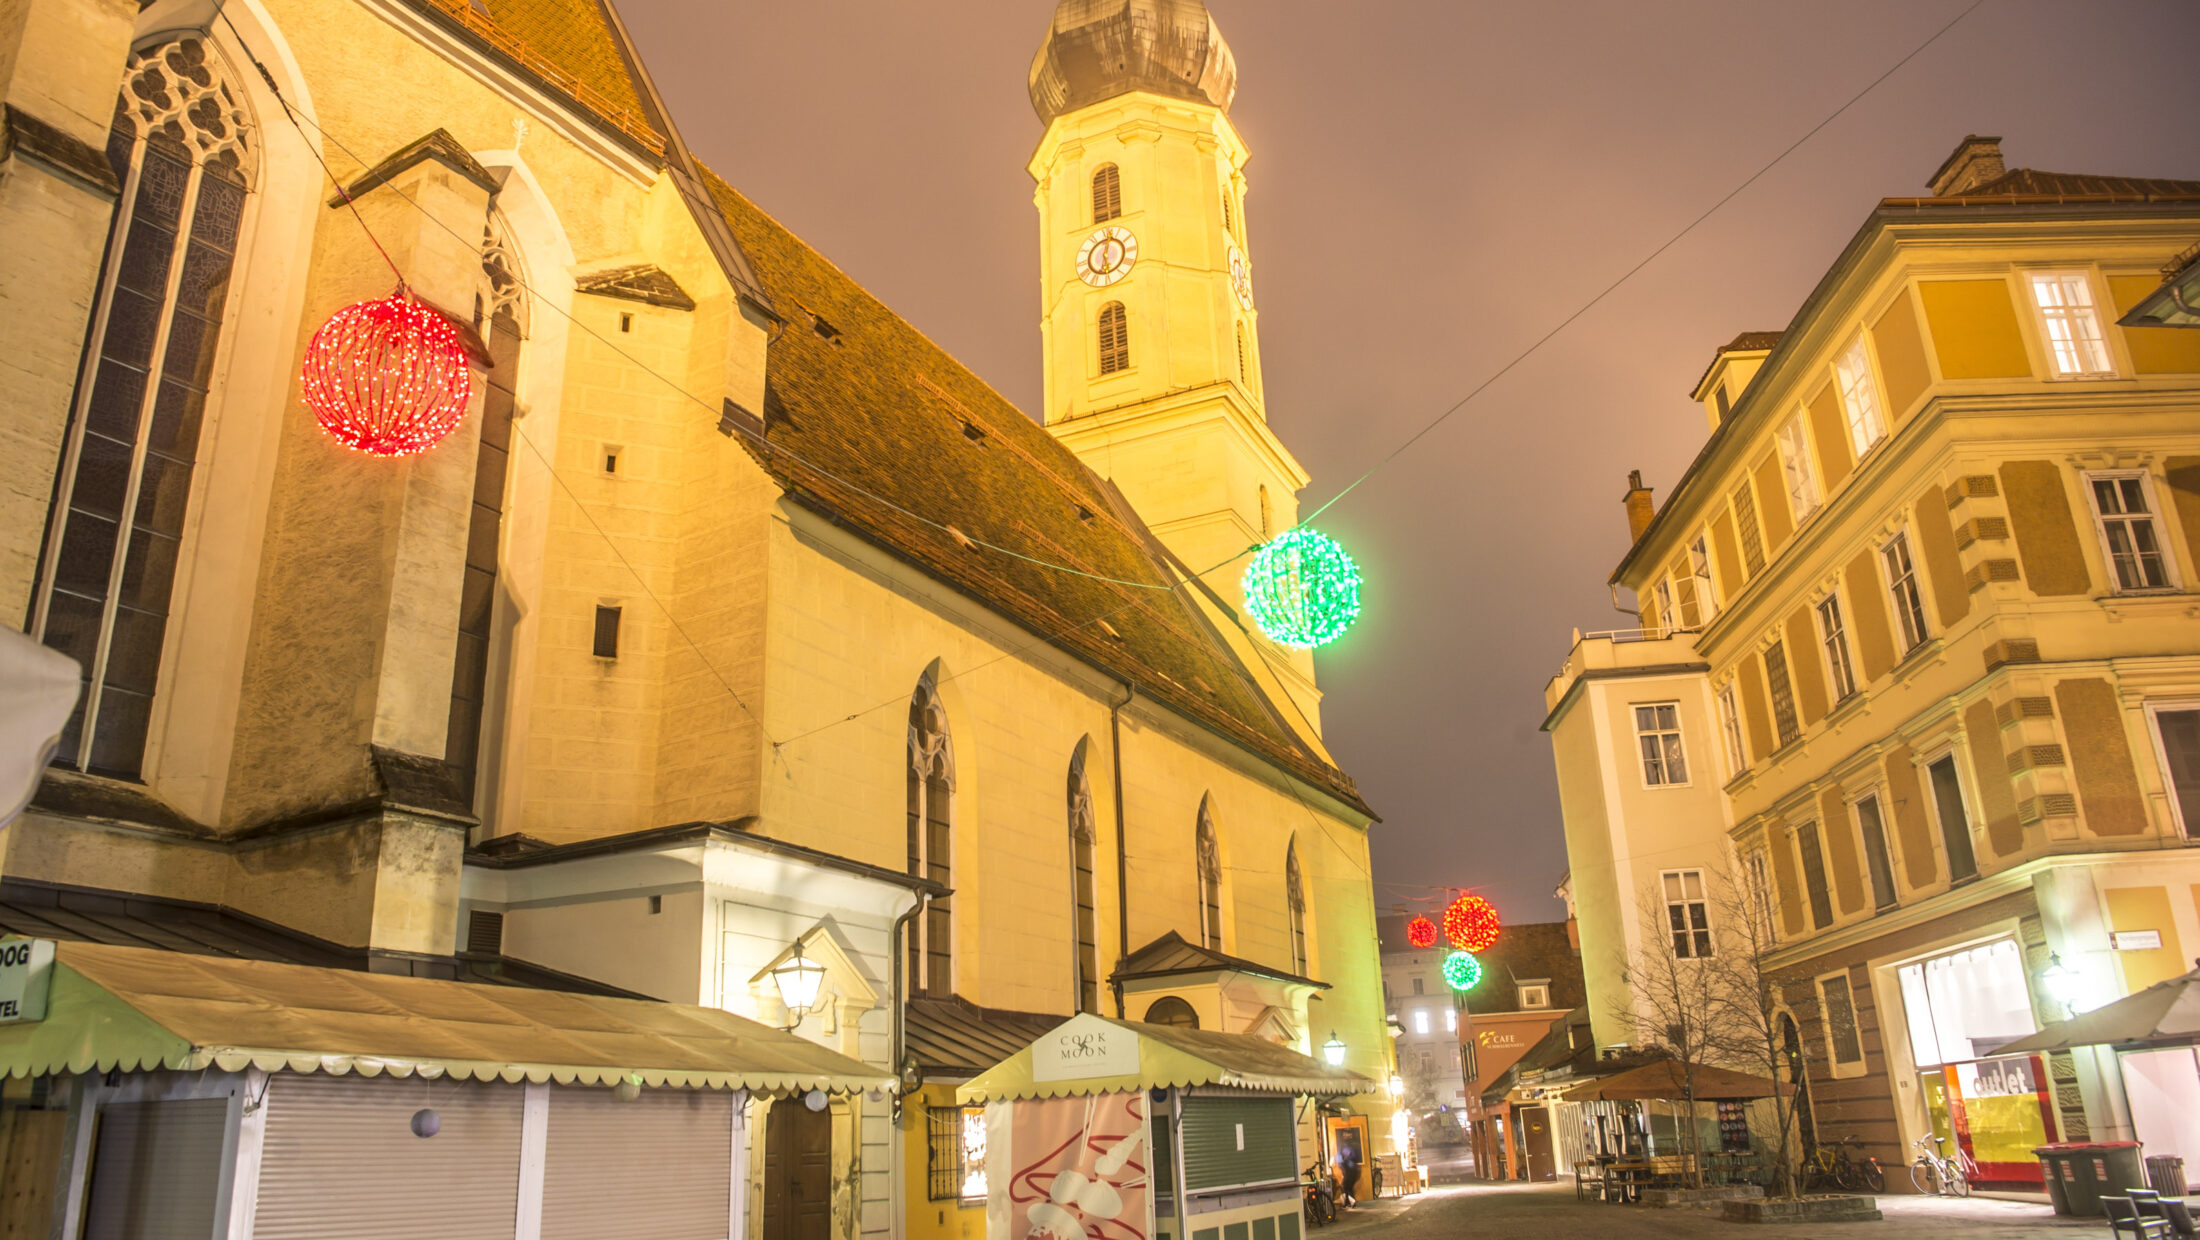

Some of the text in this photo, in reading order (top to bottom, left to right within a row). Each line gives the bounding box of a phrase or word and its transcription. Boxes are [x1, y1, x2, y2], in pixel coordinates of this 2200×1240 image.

[1060, 1032, 1106, 1046] COOK
[1493, 1034, 1515, 1044] CAFE
[1061, 1046, 1107, 1060] MOON
[1973, 1060, 2029, 1097] outlet
